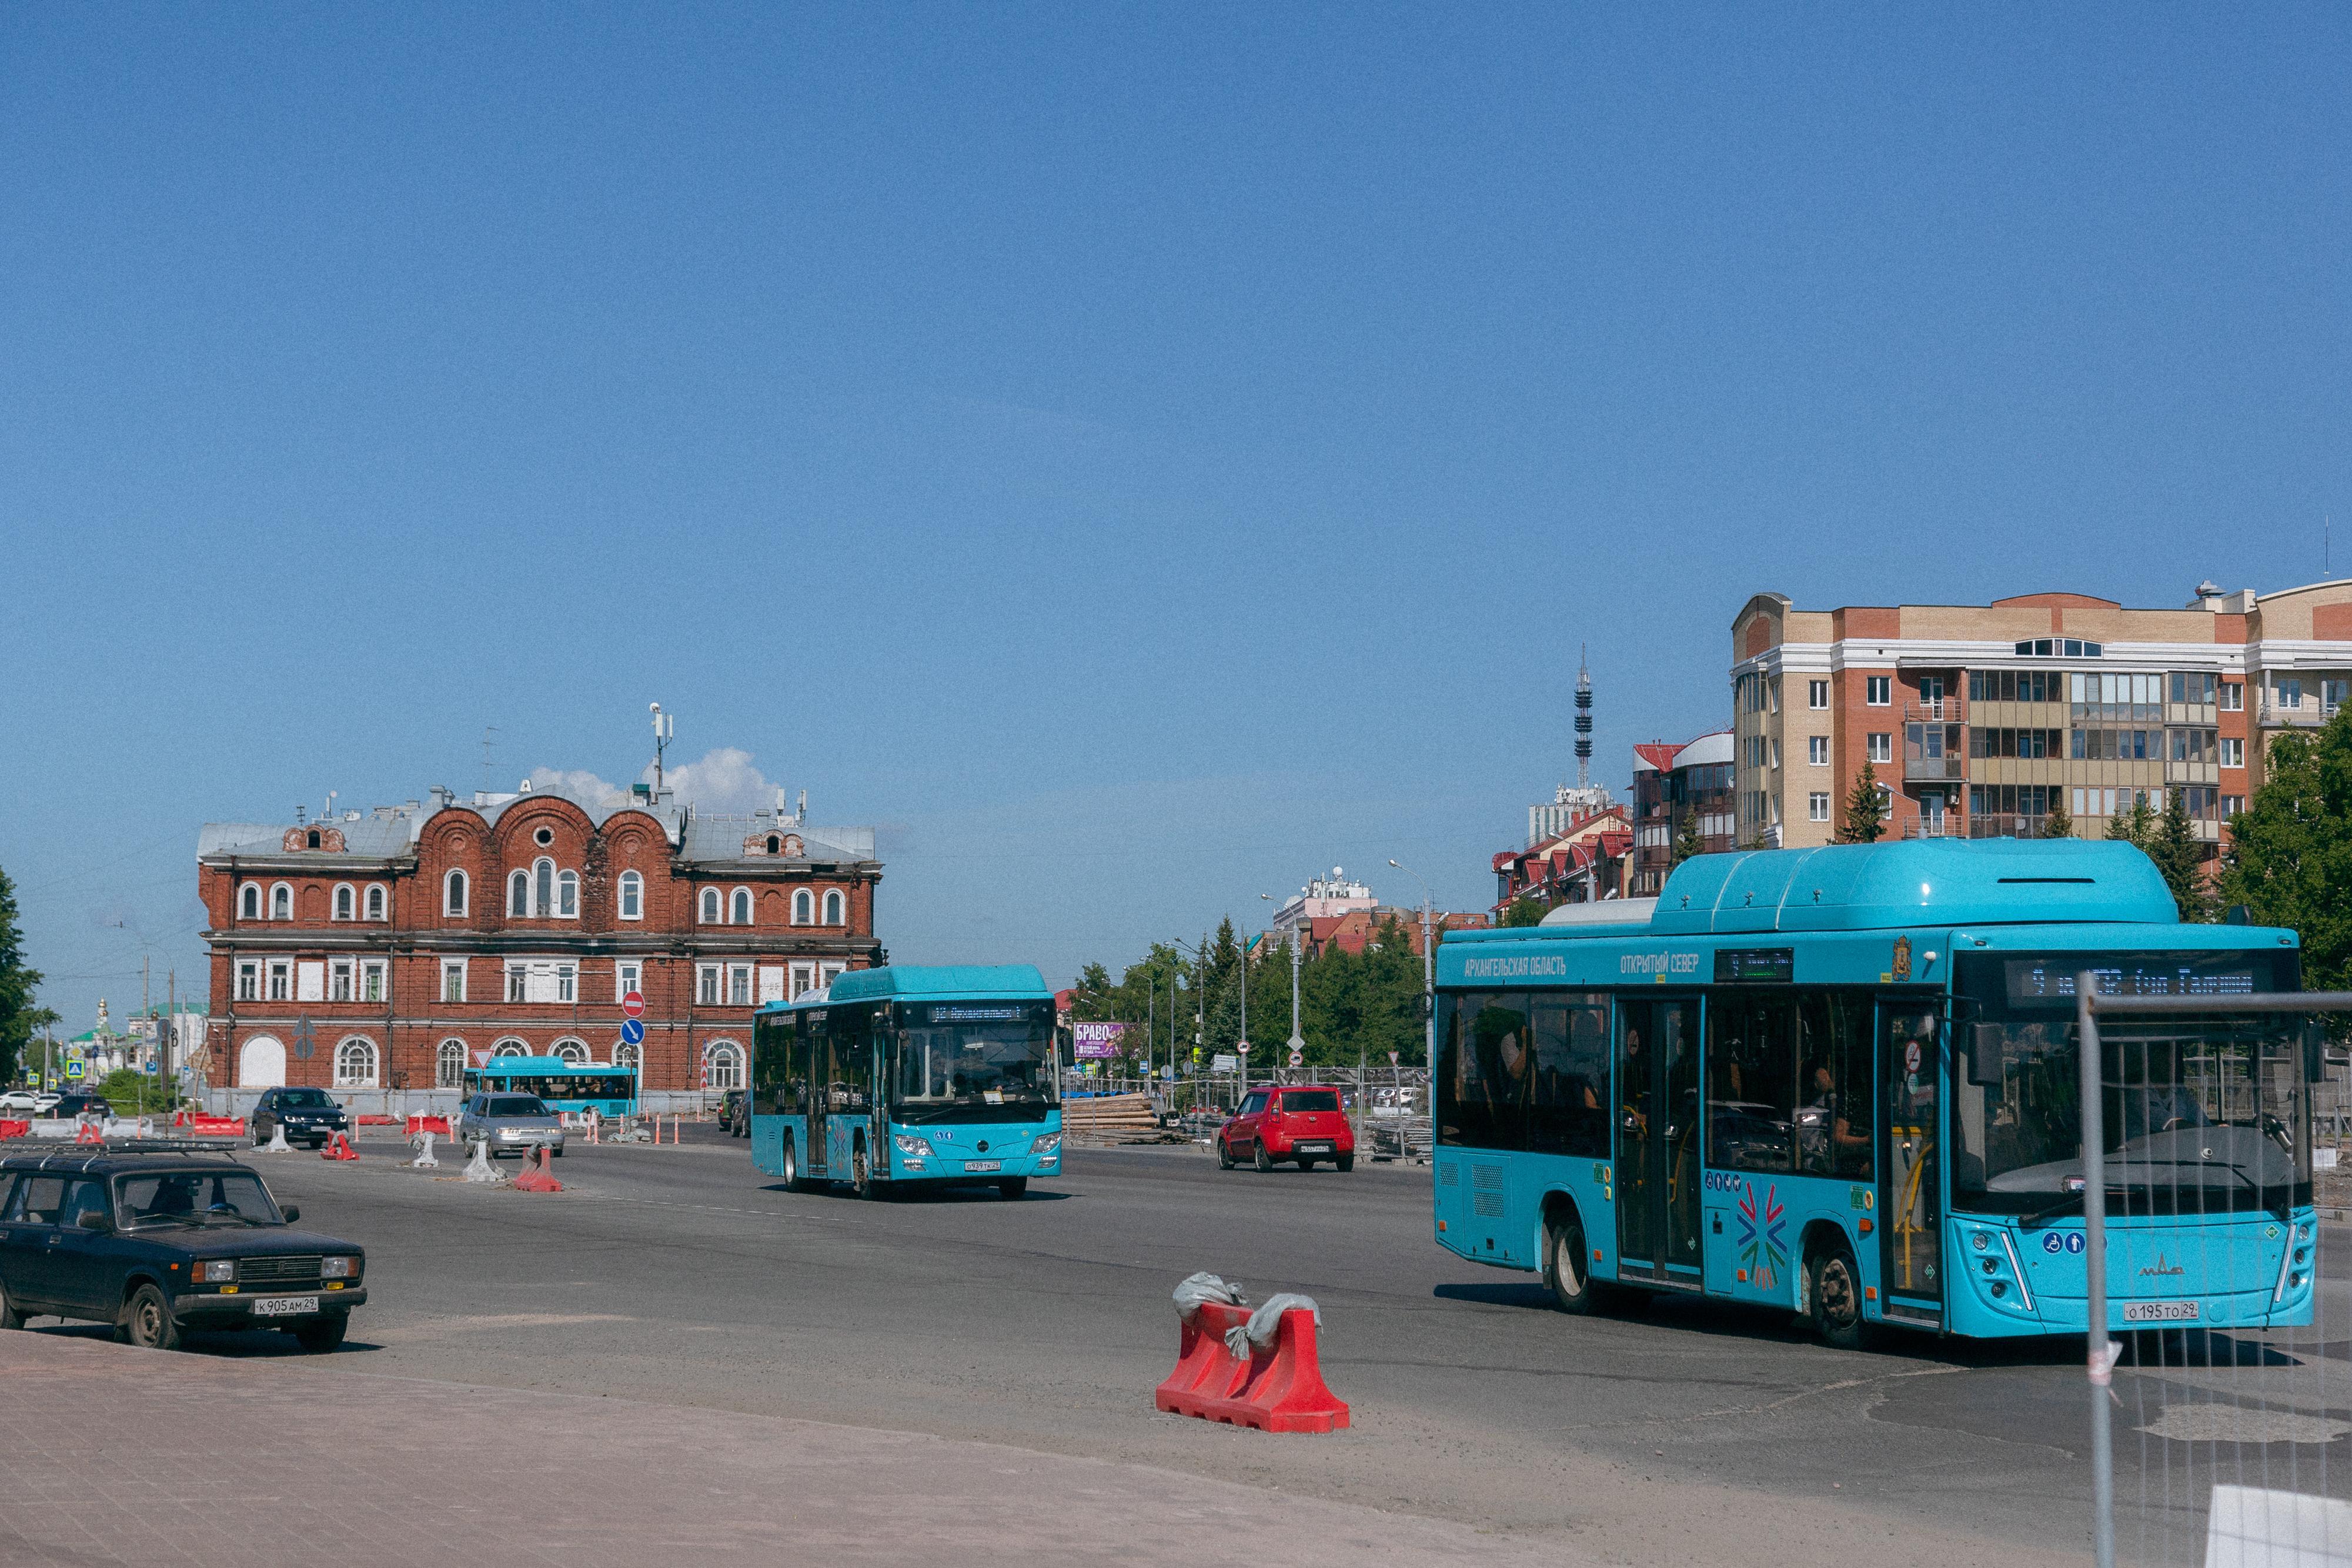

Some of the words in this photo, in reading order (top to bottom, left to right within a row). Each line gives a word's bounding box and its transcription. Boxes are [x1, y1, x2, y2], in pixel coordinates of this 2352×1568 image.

[1465, 957, 1528, 977] АРХАНГЕЛЬСКАЯ
[1530, 956, 1566, 976] ОБЛАСТЬ
[1621, 951, 1669, 974] ОТКРЫТЫЙ
[1671, 954, 1699, 973] СЕВЕР
[2032, 969, 2044, 995] 9
[1077, 1025, 1109, 1041] БРАВО
[304, 1298, 315, 1308] 29
[2183, 1303, 2194, 1314] 29
